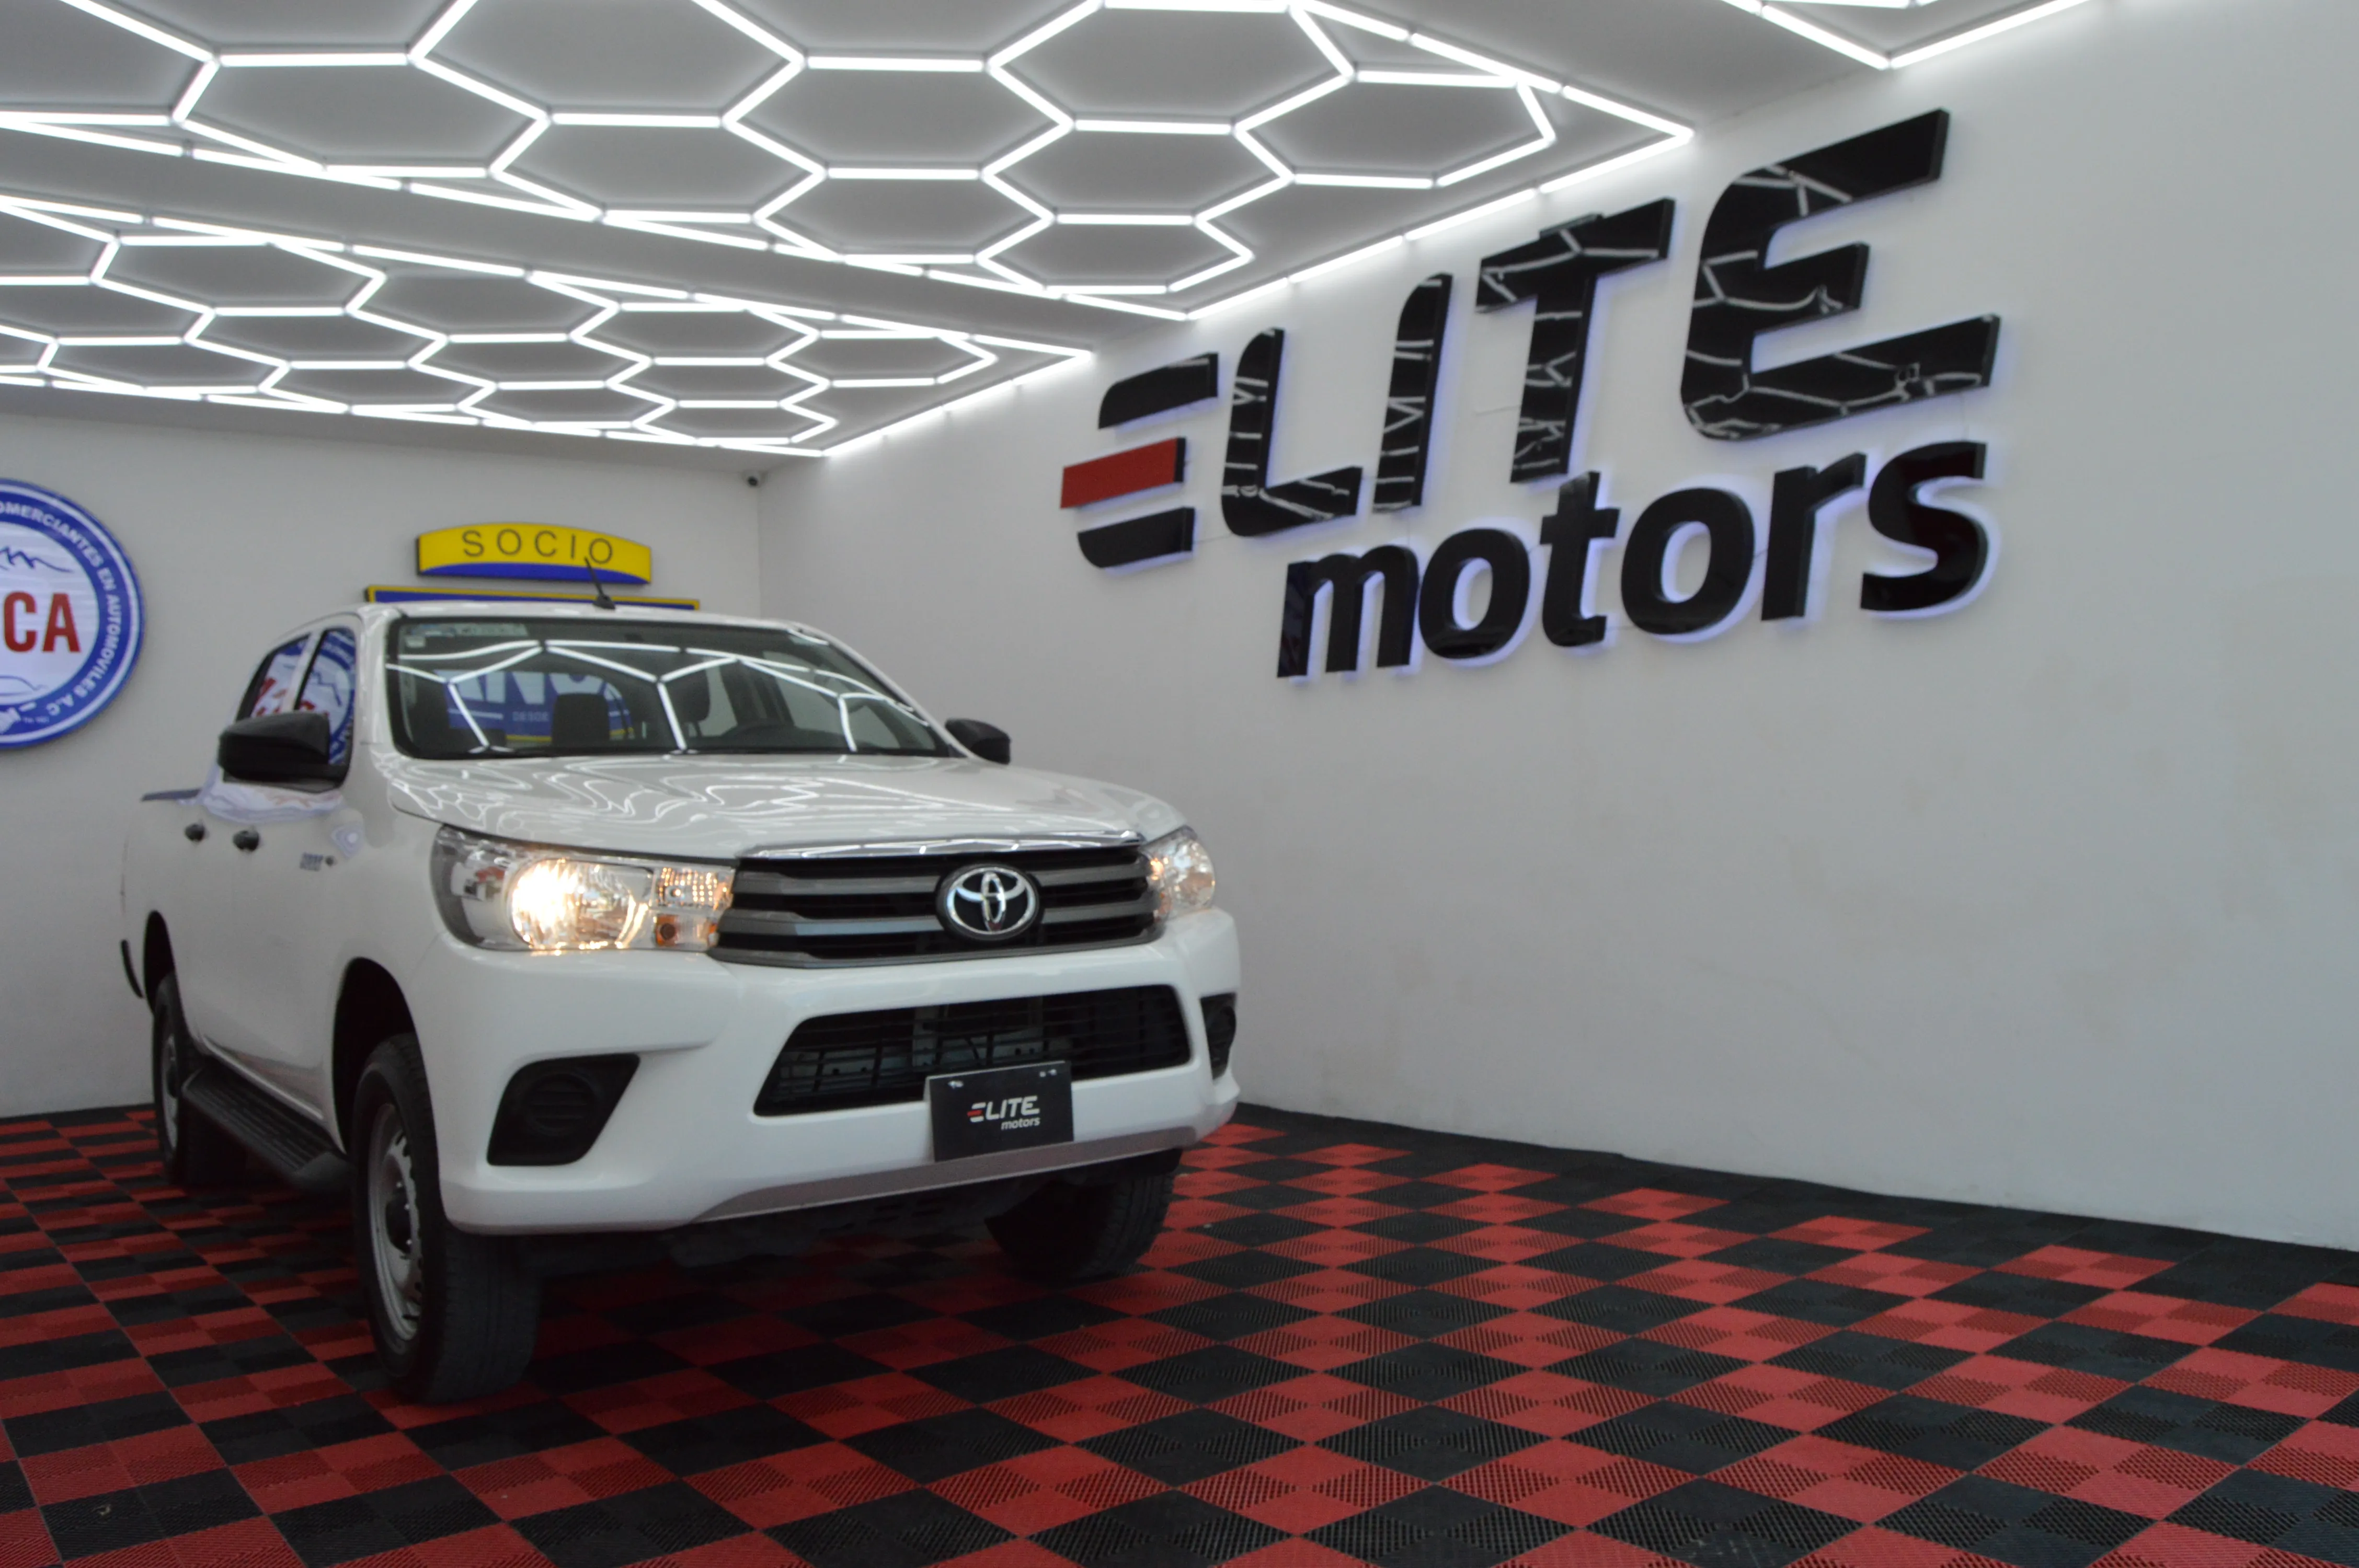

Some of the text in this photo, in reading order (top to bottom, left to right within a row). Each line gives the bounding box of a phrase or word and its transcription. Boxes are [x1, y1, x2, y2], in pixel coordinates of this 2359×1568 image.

[1061, 109, 2001, 570] ELITE
[462, 528, 613, 565] SOCIO
[1277, 442, 1988, 678] motors
[97, 567, 116, 591] EN
[74, 594, 122, 698] AUTOMOVILES
[967, 1096, 1040, 1123] ELITE
[1001, 1117, 1040, 1131] motors
